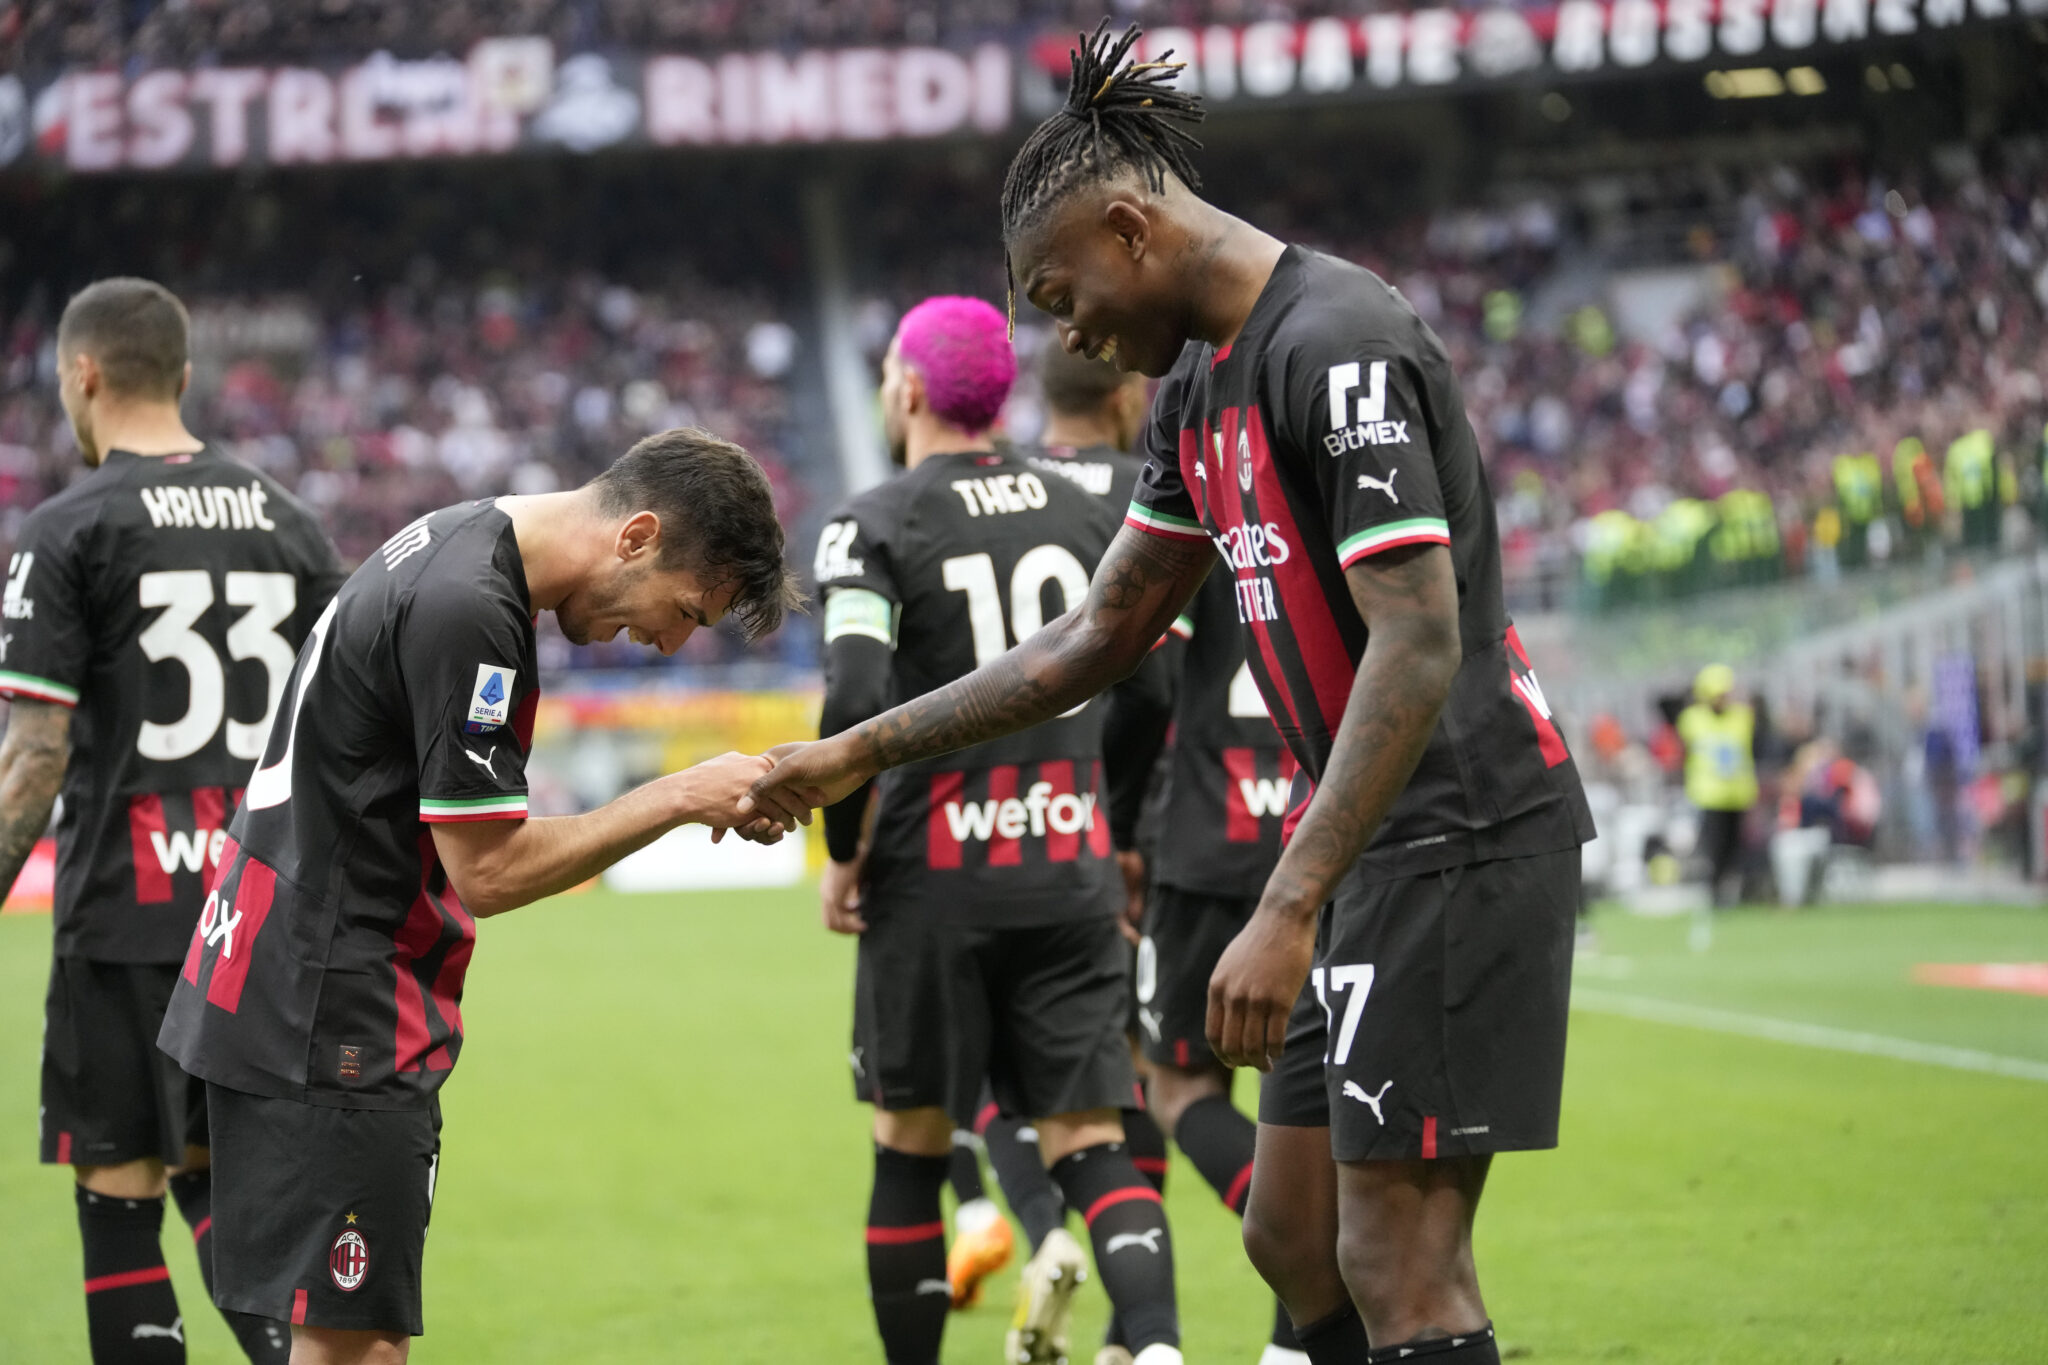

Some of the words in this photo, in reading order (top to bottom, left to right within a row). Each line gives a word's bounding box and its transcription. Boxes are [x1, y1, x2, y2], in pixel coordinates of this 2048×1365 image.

[644, 40, 1013, 147] RIMEDI
[1322, 420, 1411, 457] BitMEX
[139, 479, 276, 531] KRUNIĆ
[951, 472, 1049, 517] THEO
[1206, 519, 1290, 574] rates
[136, 569, 298, 762] 33
[474, 706, 496, 718] SERIE
[480, 724, 498, 733] TIM
[1311, 963, 1375, 1065] 17
[339, 1232, 362, 1244] ACM
[338, 1276, 358, 1284] 1899
